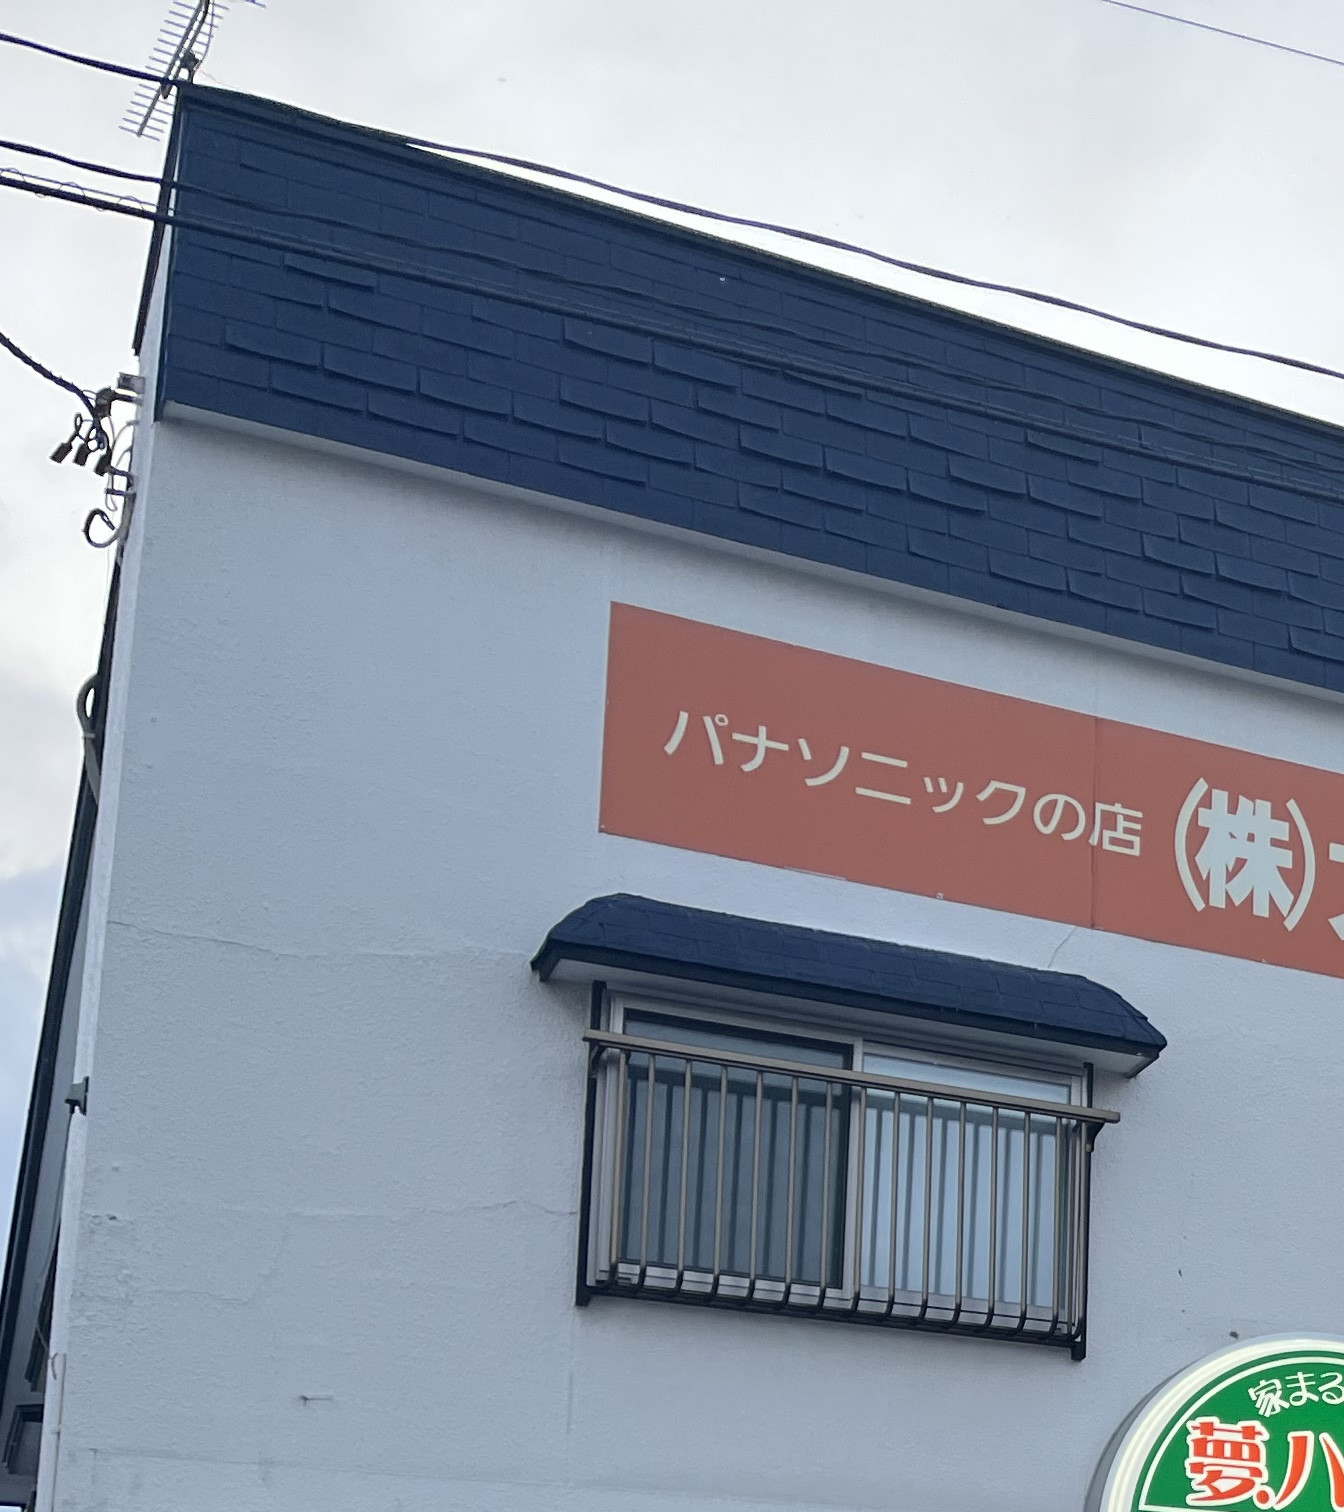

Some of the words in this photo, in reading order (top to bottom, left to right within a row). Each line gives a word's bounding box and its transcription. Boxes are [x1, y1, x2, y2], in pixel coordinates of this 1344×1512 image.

[665, 709, 1143, 858] パナソニックの店
